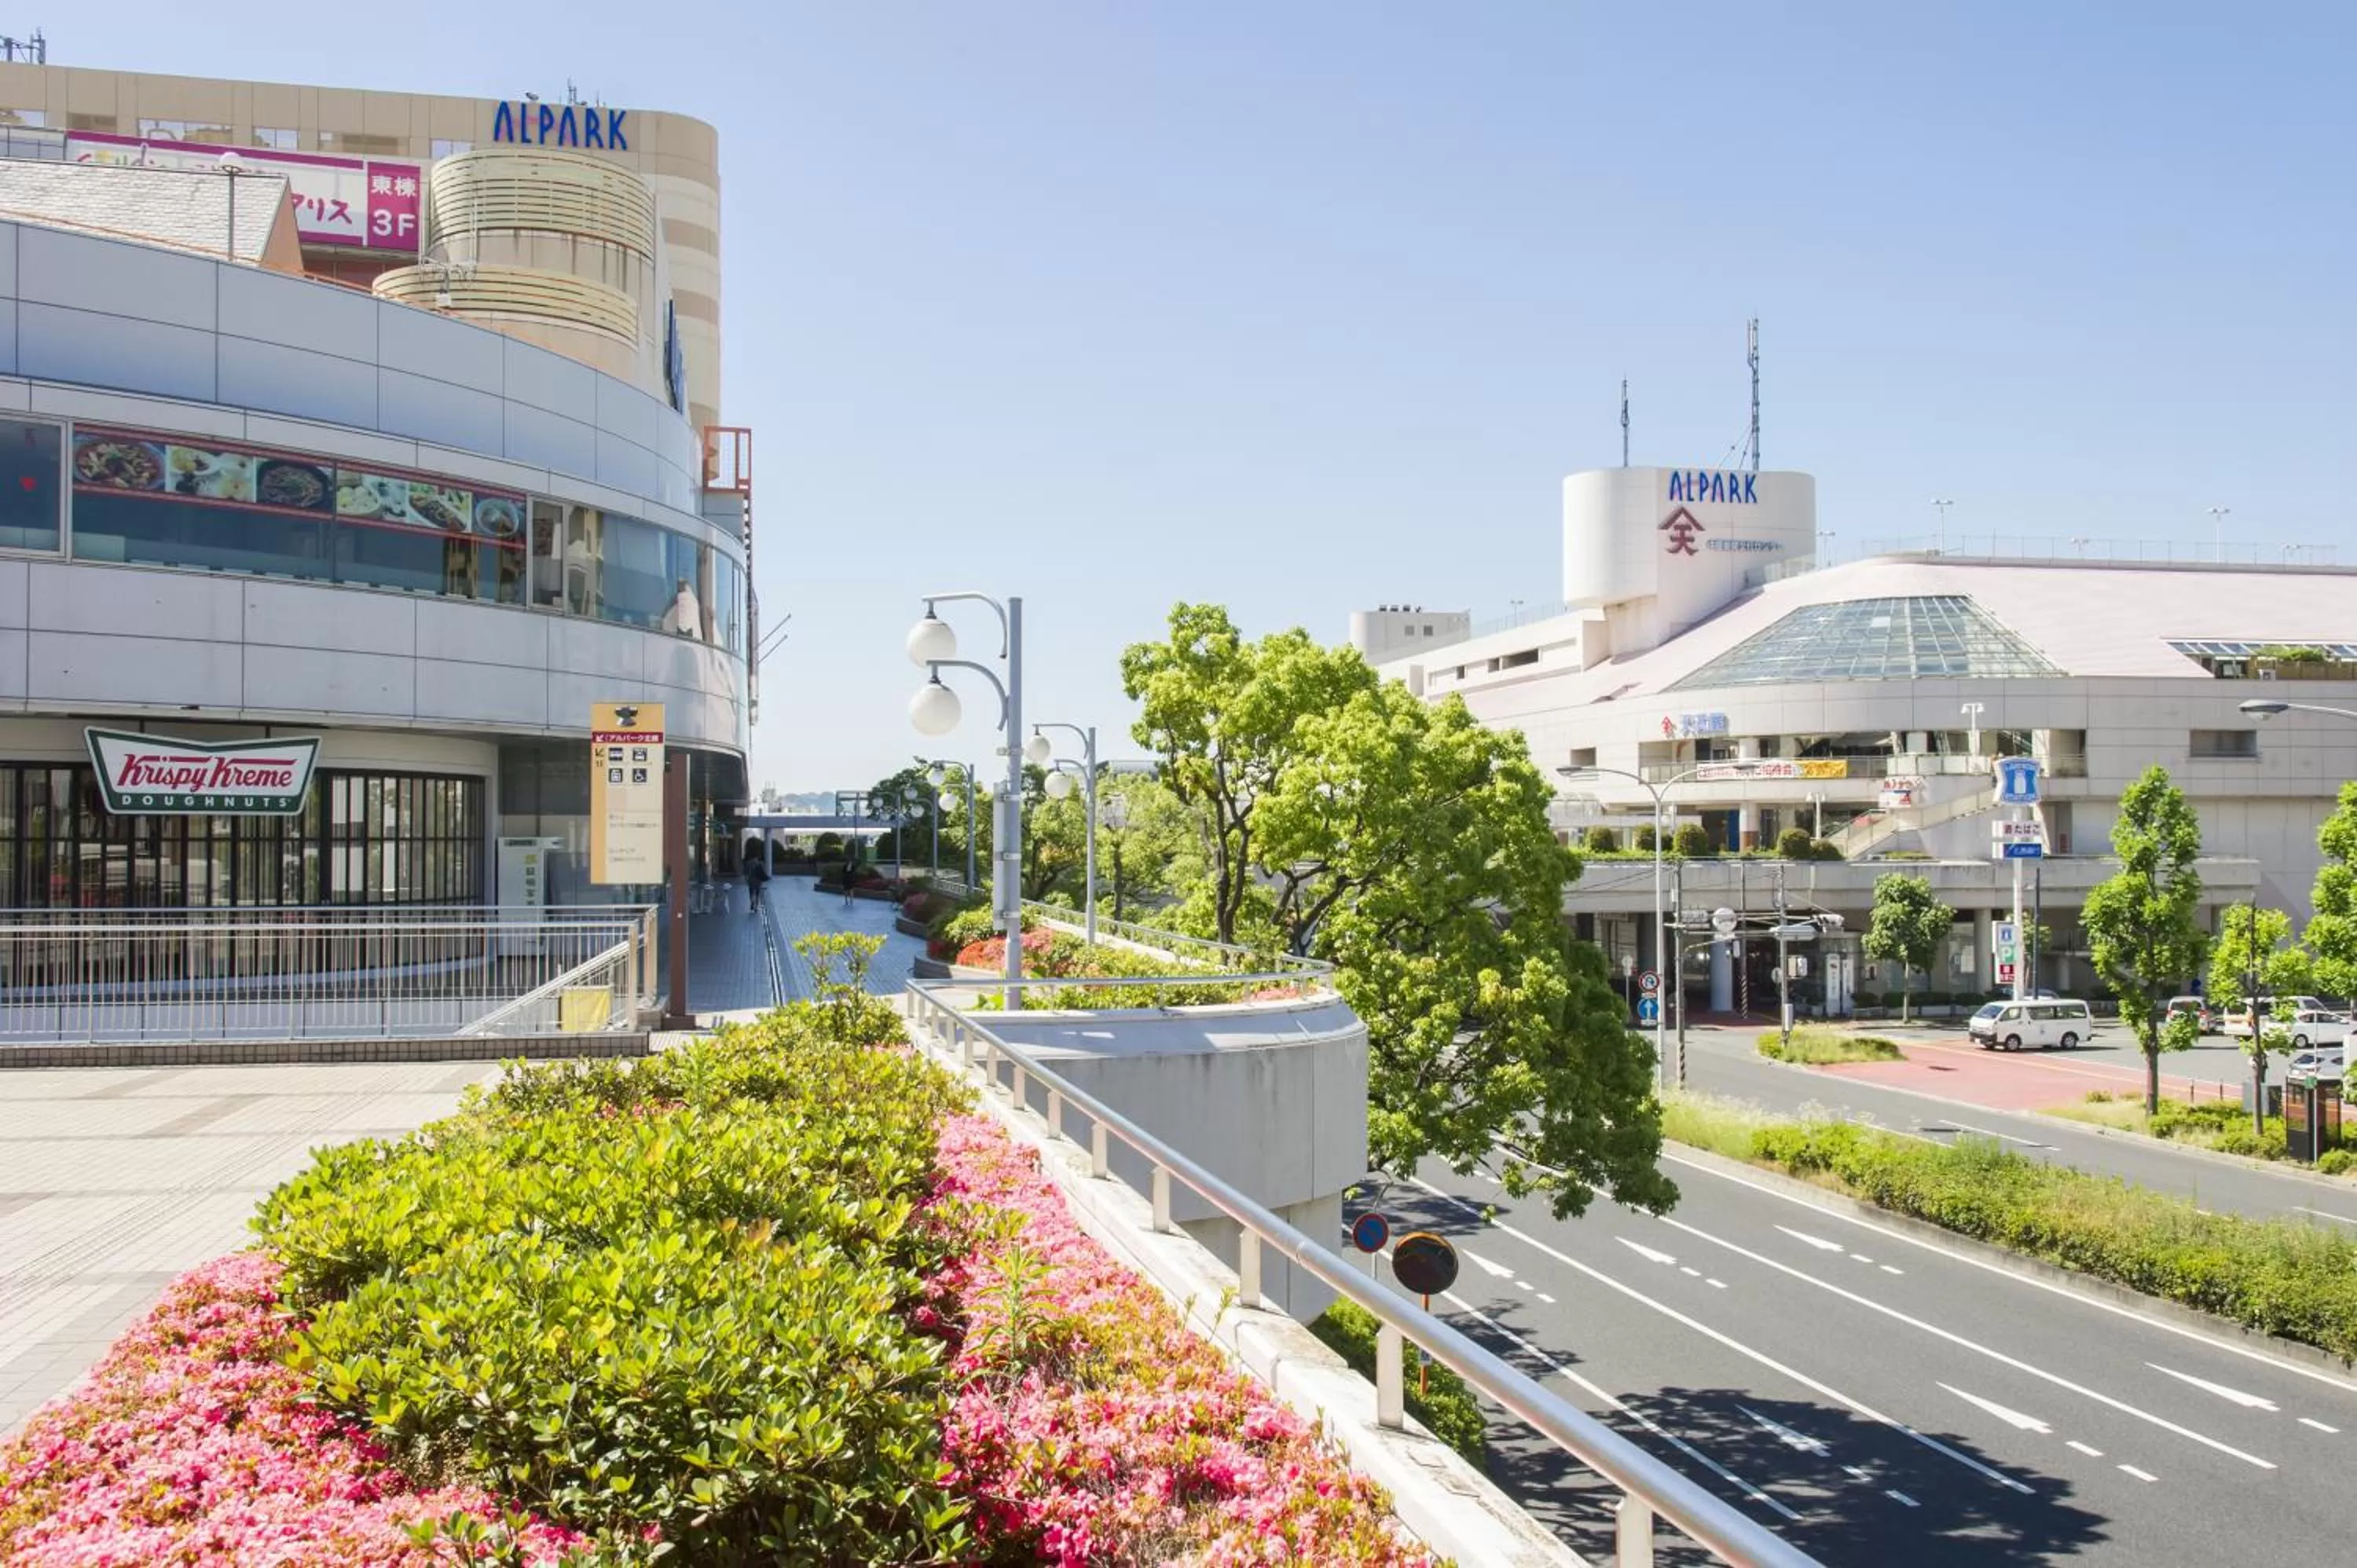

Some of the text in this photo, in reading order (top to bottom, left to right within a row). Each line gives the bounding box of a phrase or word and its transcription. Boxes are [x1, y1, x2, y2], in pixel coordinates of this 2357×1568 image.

[493, 101, 627, 151] ALPARK
[371, 175, 416, 197] 東棟
[372, 208, 416, 237] 3F
[1669, 471, 1758, 504] ALPARK
[117, 753, 297, 793] Krispy Kreme
[122, 795, 288, 808] DOUGHNUTS
